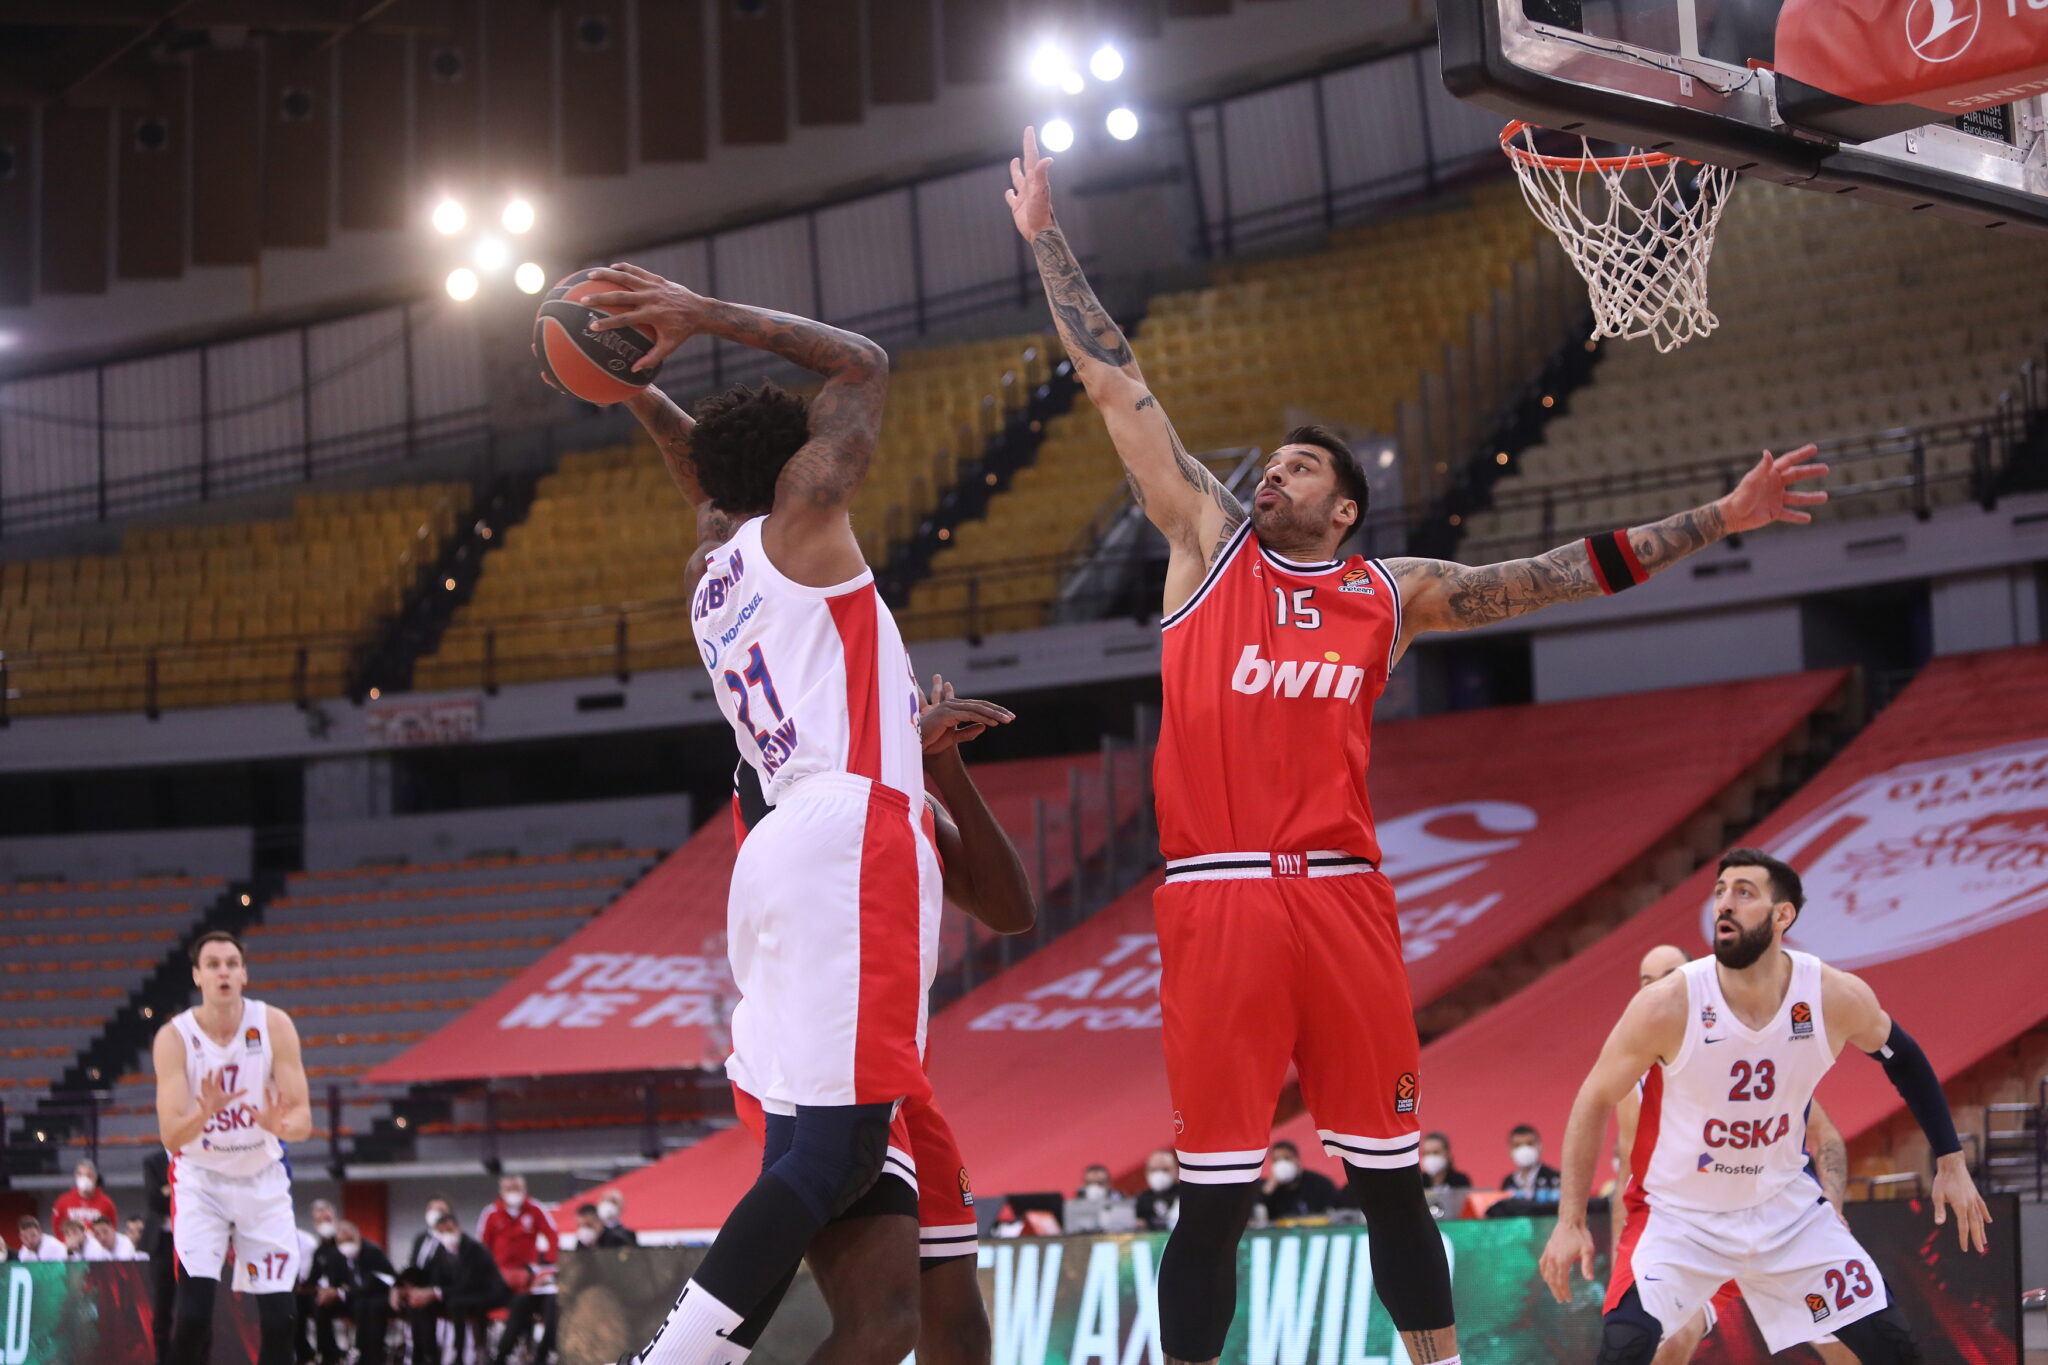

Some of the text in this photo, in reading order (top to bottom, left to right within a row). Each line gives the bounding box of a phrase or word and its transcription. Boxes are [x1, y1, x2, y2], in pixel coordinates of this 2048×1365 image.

[1963, 111, 2003, 130] AIRLINES
[1273, 585, 1322, 630] 15
[1231, 644, 1365, 705] bwin
[724, 641, 785, 752] 21
[1278, 854, 1301, 875] OLY
[546, 952, 730, 991] TOGE
[1728, 1059, 1776, 1102] 23
[1703, 1113, 1790, 1150] CSKA
[263, 1254, 289, 1280] 17
[1824, 1259, 1874, 1312] 23
[977, 1243, 1064, 1365] W
